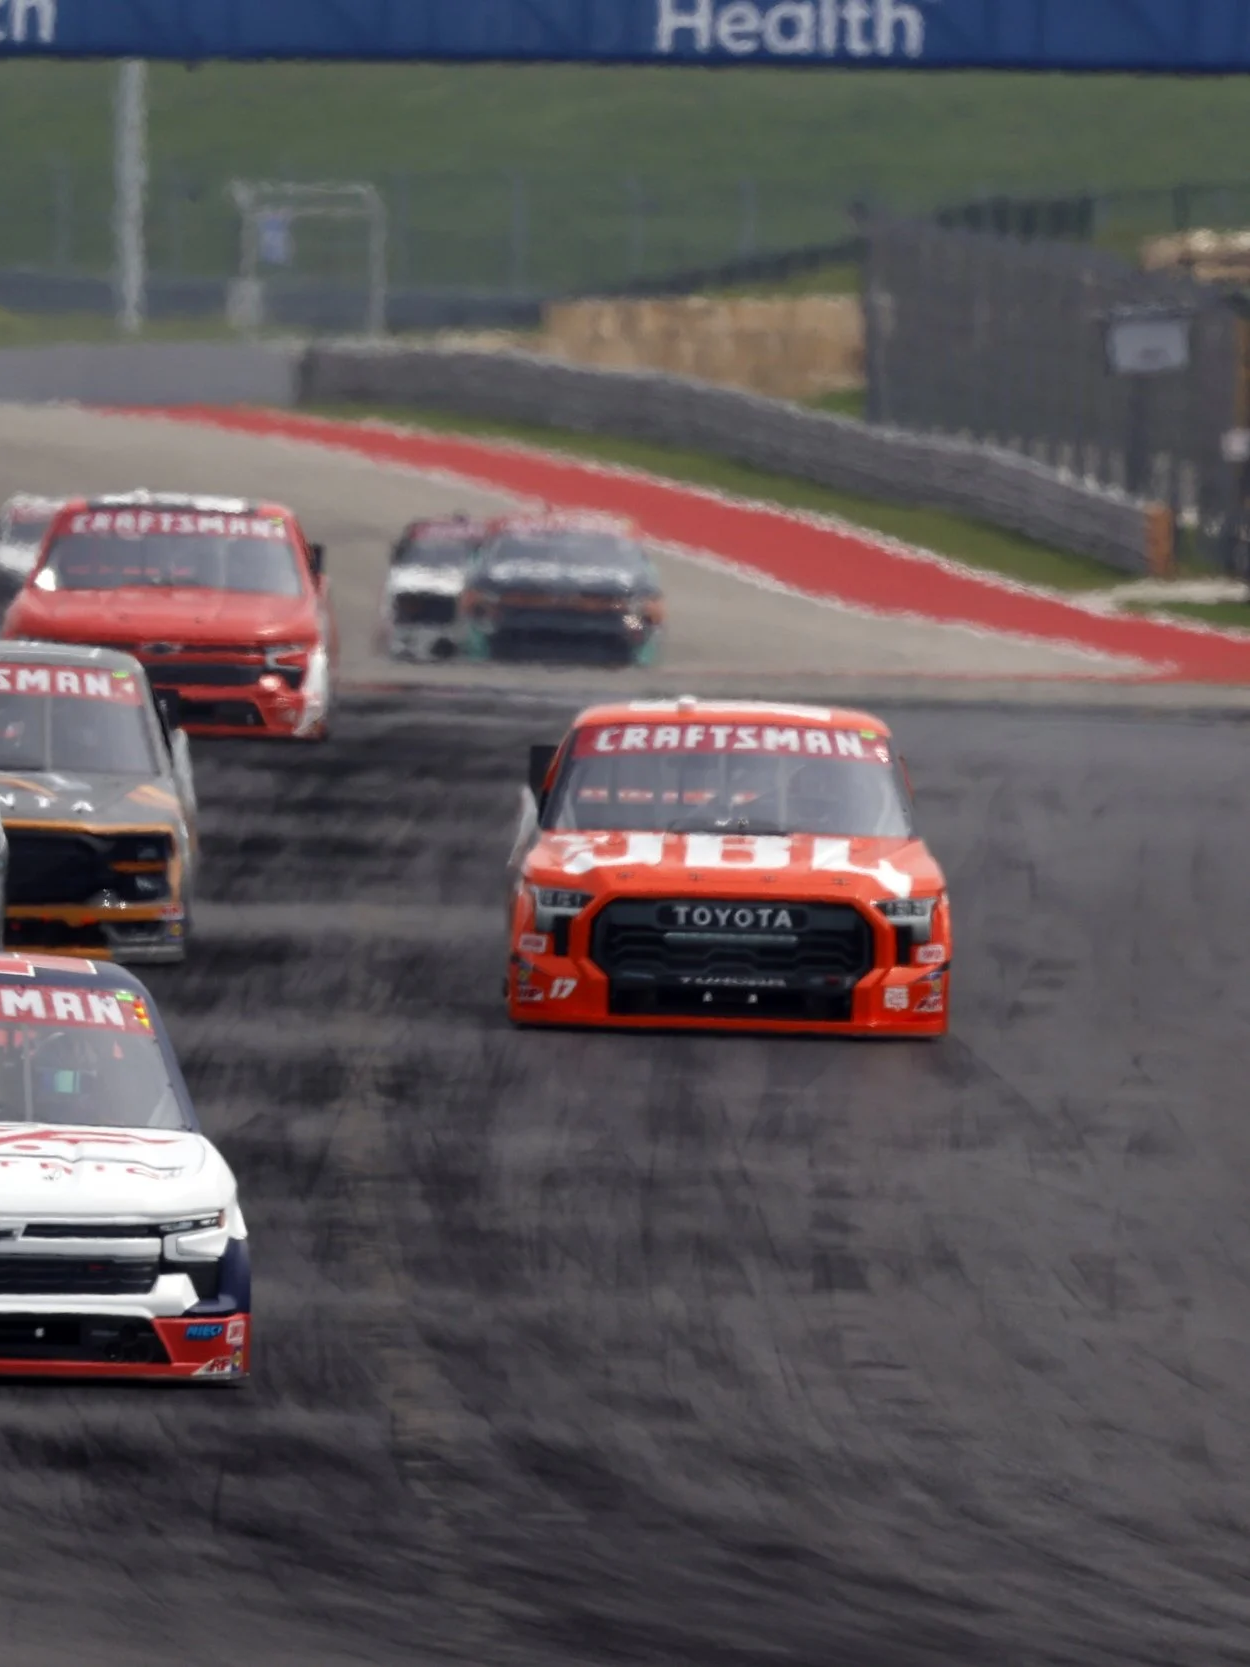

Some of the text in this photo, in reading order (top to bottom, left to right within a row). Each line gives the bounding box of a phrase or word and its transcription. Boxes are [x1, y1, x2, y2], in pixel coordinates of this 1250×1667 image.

[654, 0, 925, 58] Health
[71, 511, 271, 538] CRAFTSMAN
[594, 724, 865, 758] CRAFTSMAN
[672, 905, 794, 929] TOYOTA
[549, 977, 578, 1000] 17
